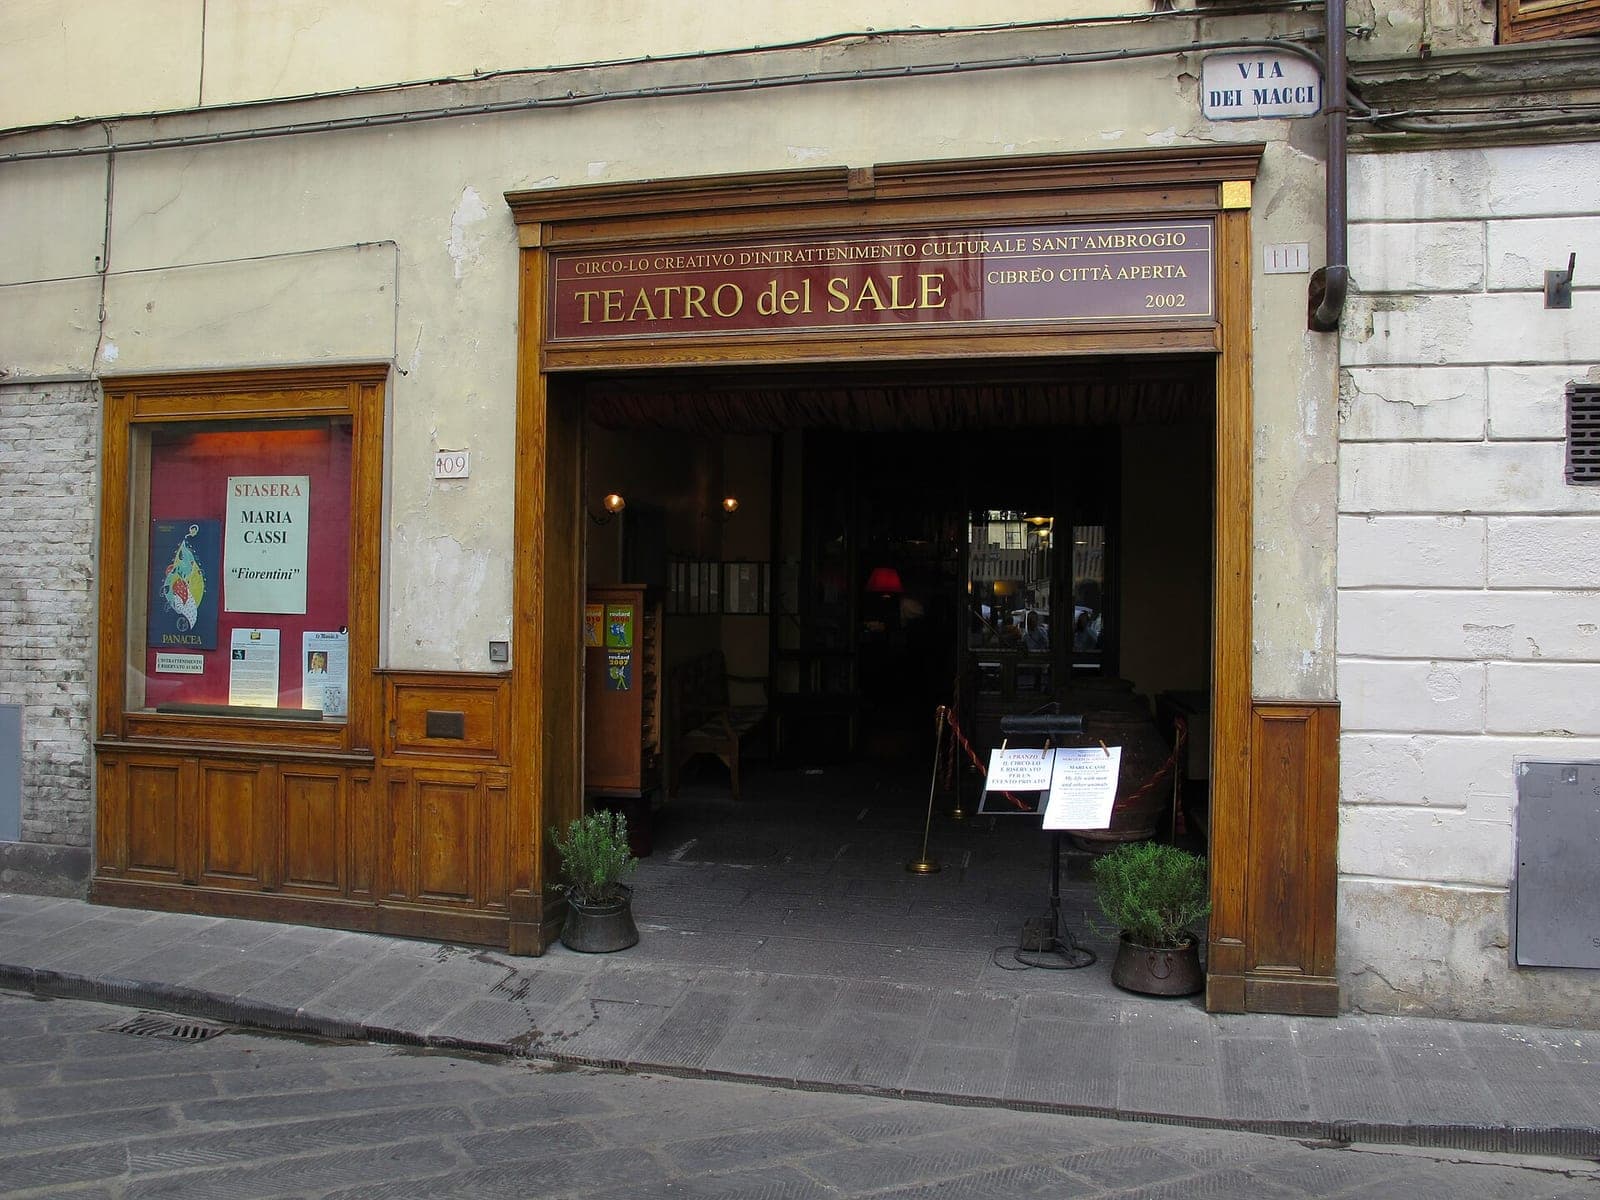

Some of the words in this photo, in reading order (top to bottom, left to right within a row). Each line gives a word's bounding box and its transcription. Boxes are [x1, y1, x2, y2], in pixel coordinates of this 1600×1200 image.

[1238, 61, 1284, 79] VIA
[1209, 89, 1242, 107] DEI
[1252, 86, 1314, 105] MACCI
[575, 258, 649, 275] CIRCO-LO
[654, 253, 735, 270] CREATIVO
[740, 243, 916, 265] D'INTRATTENIMENTO
[922, 238, 1026, 256] CULTURALE
[1032, 232, 1186, 252] SANT'AMBROGIO
[1060, 264, 1112, 282] CITTÀ
[1117, 264, 1187, 280] APERTA
[575, 283, 744, 324] TEATRO
[757, 278, 813, 316] del
[826, 273, 947, 313] SALE
[1145, 294, 1186, 308] 2002
[234, 484, 301, 497] STASERA
[240, 510, 292, 524] MARIA
[244, 530, 288, 544] CASSI
[162, 634, 203, 645] PANACEA
